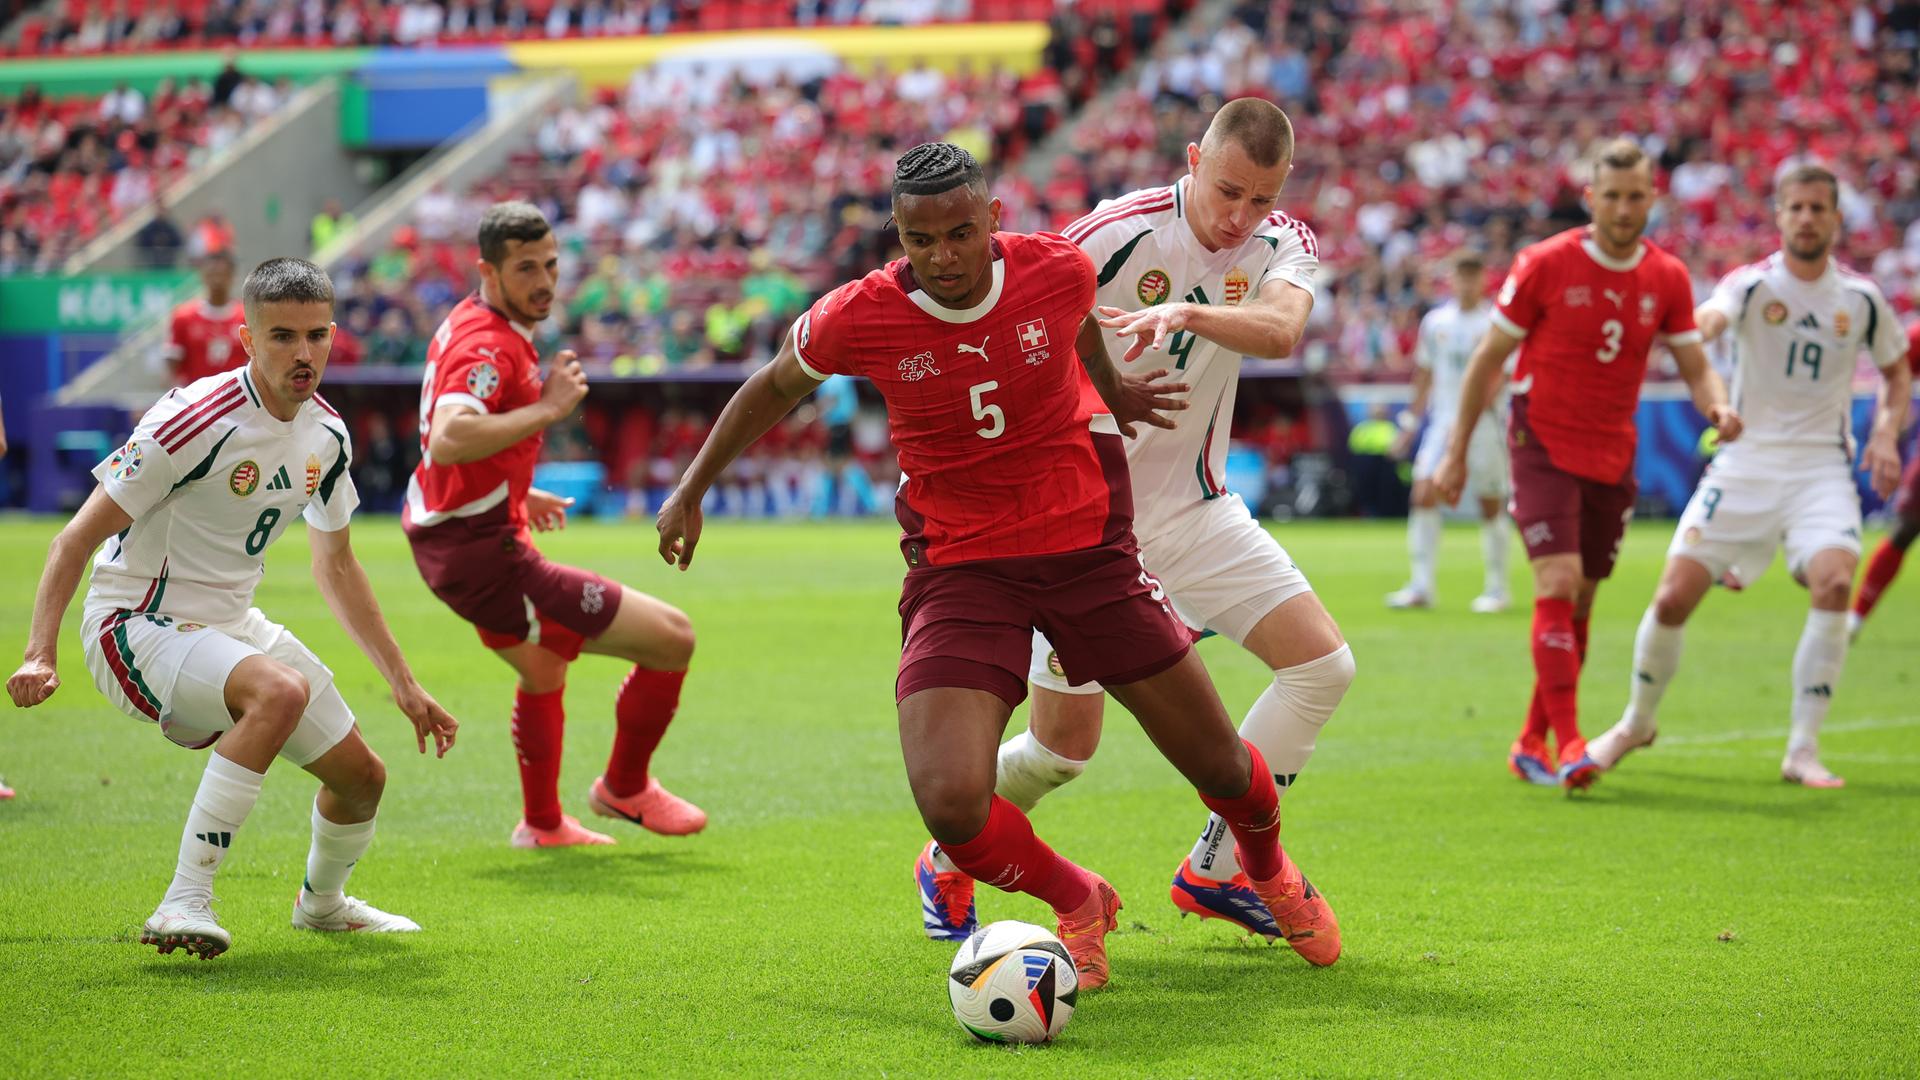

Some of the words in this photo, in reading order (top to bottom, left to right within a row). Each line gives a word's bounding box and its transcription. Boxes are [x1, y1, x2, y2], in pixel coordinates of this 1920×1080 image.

[1168, 328, 1196, 370] 4
[1595, 318, 1624, 364] 3
[1785, 340, 1823, 380] 19
[969, 380, 1006, 439] 5
[245, 508, 281, 556] 8
